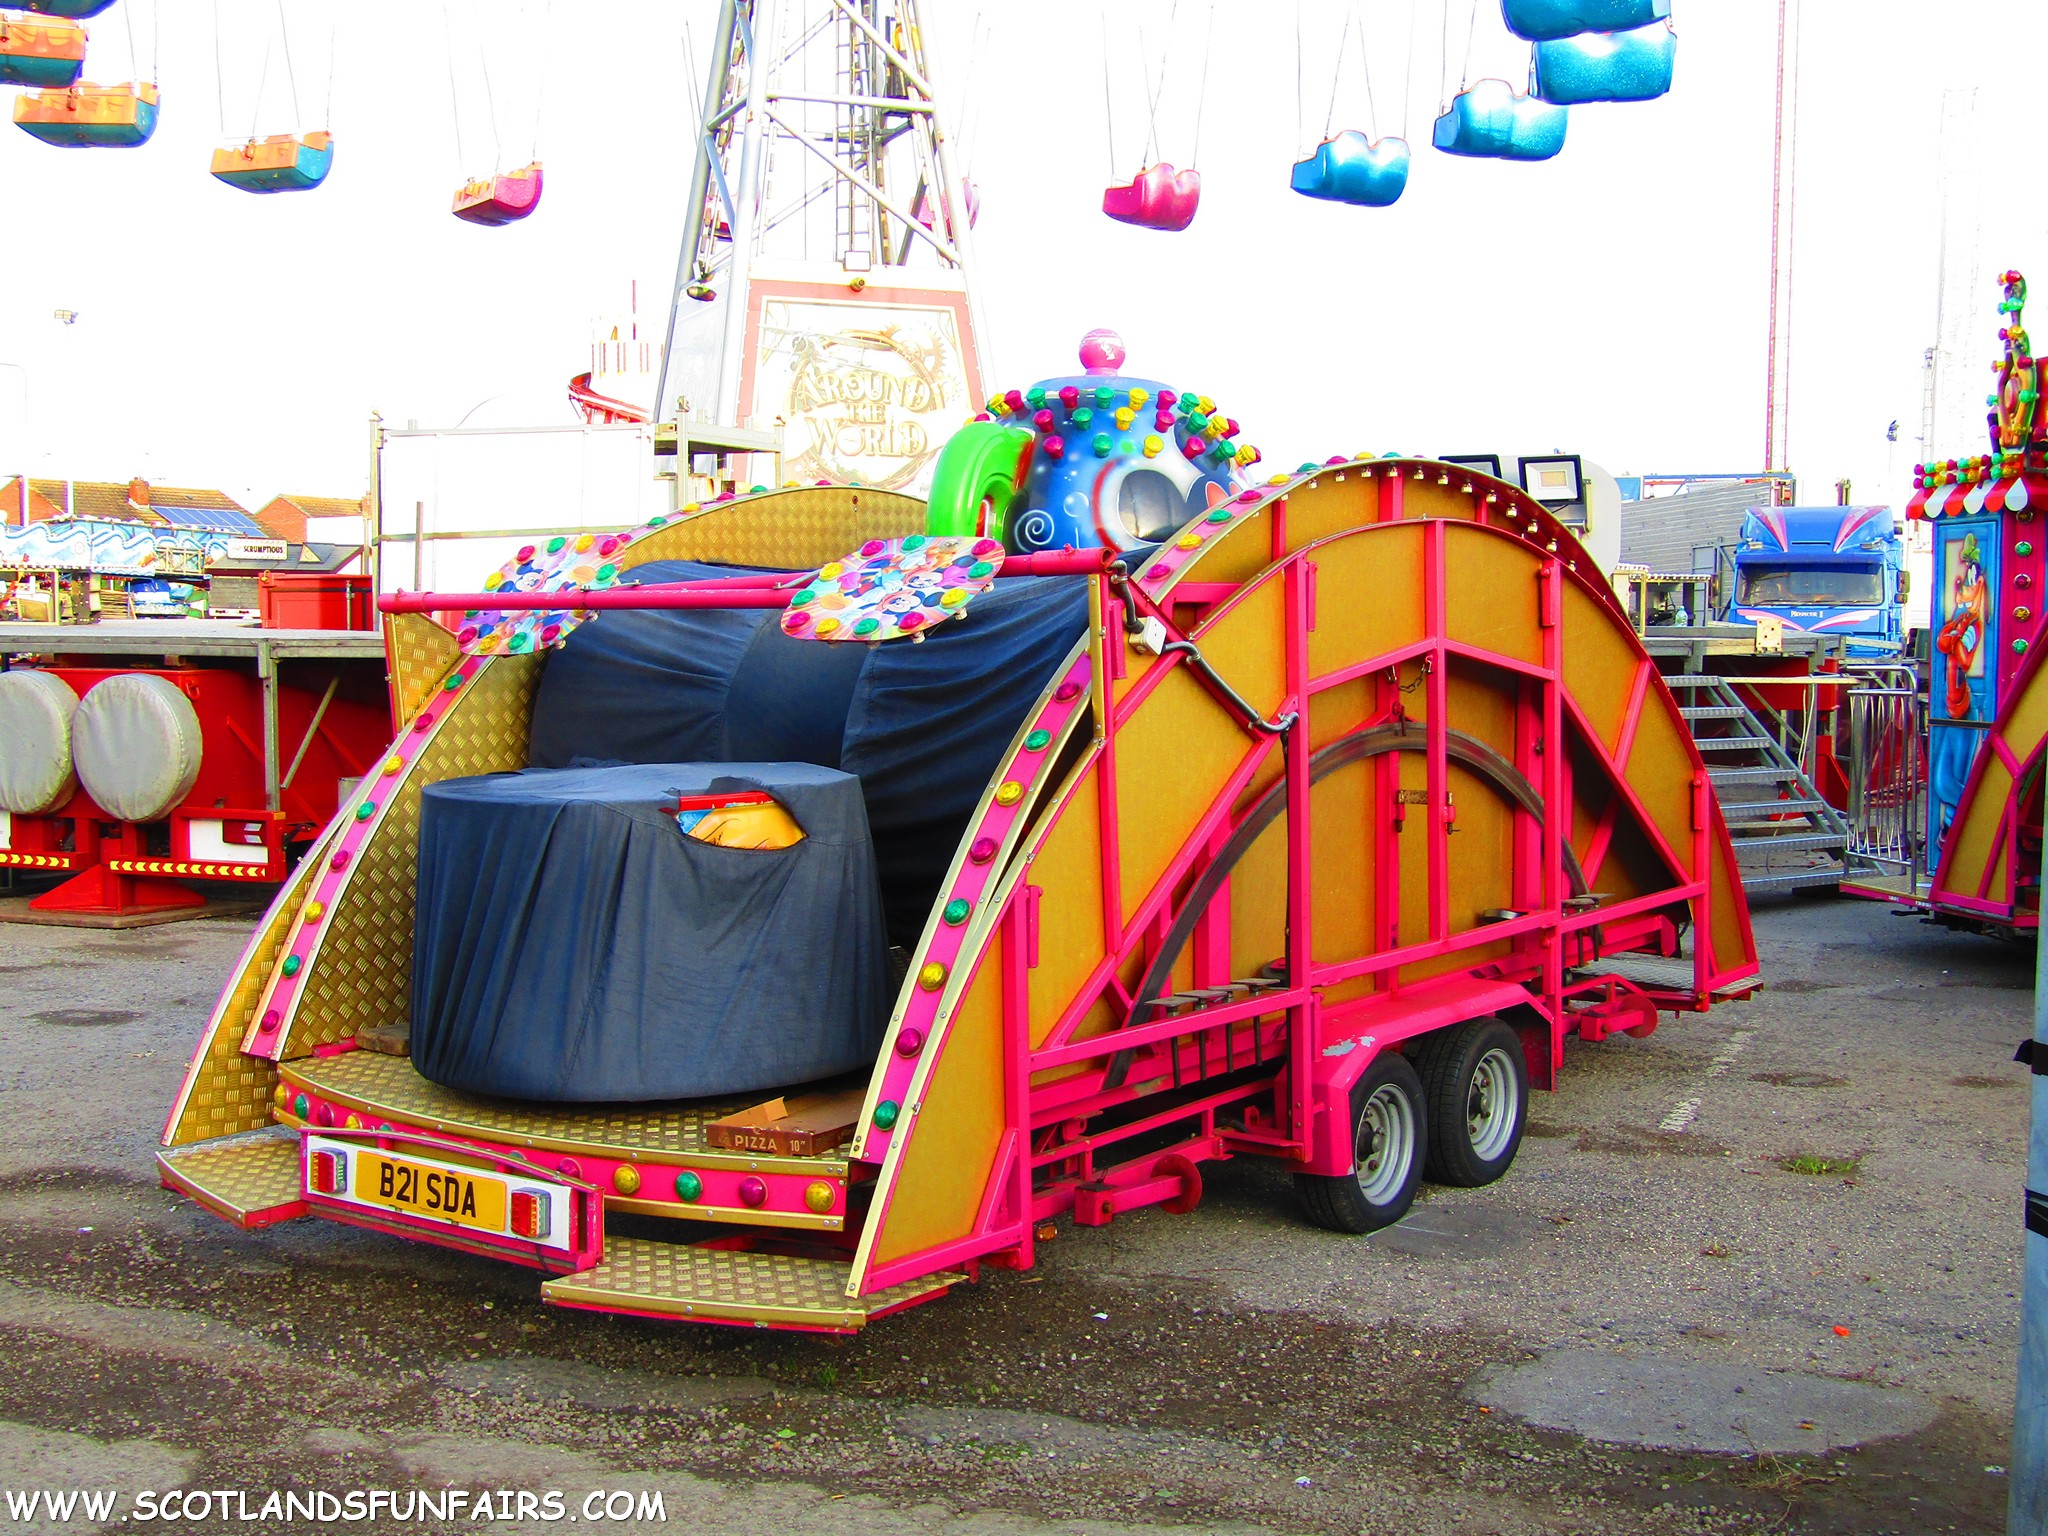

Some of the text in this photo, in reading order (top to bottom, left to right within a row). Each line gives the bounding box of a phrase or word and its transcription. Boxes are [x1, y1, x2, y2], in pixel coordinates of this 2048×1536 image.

[796, 371, 931, 413] AROUND
[845, 402, 886, 424] THE
[804, 417, 928, 458] WORLD
[243, 545, 284, 554] SCRUMPTIOUS
[734, 1134, 778, 1151] PIZZA
[379, 1161, 477, 1218] B21 SDA
